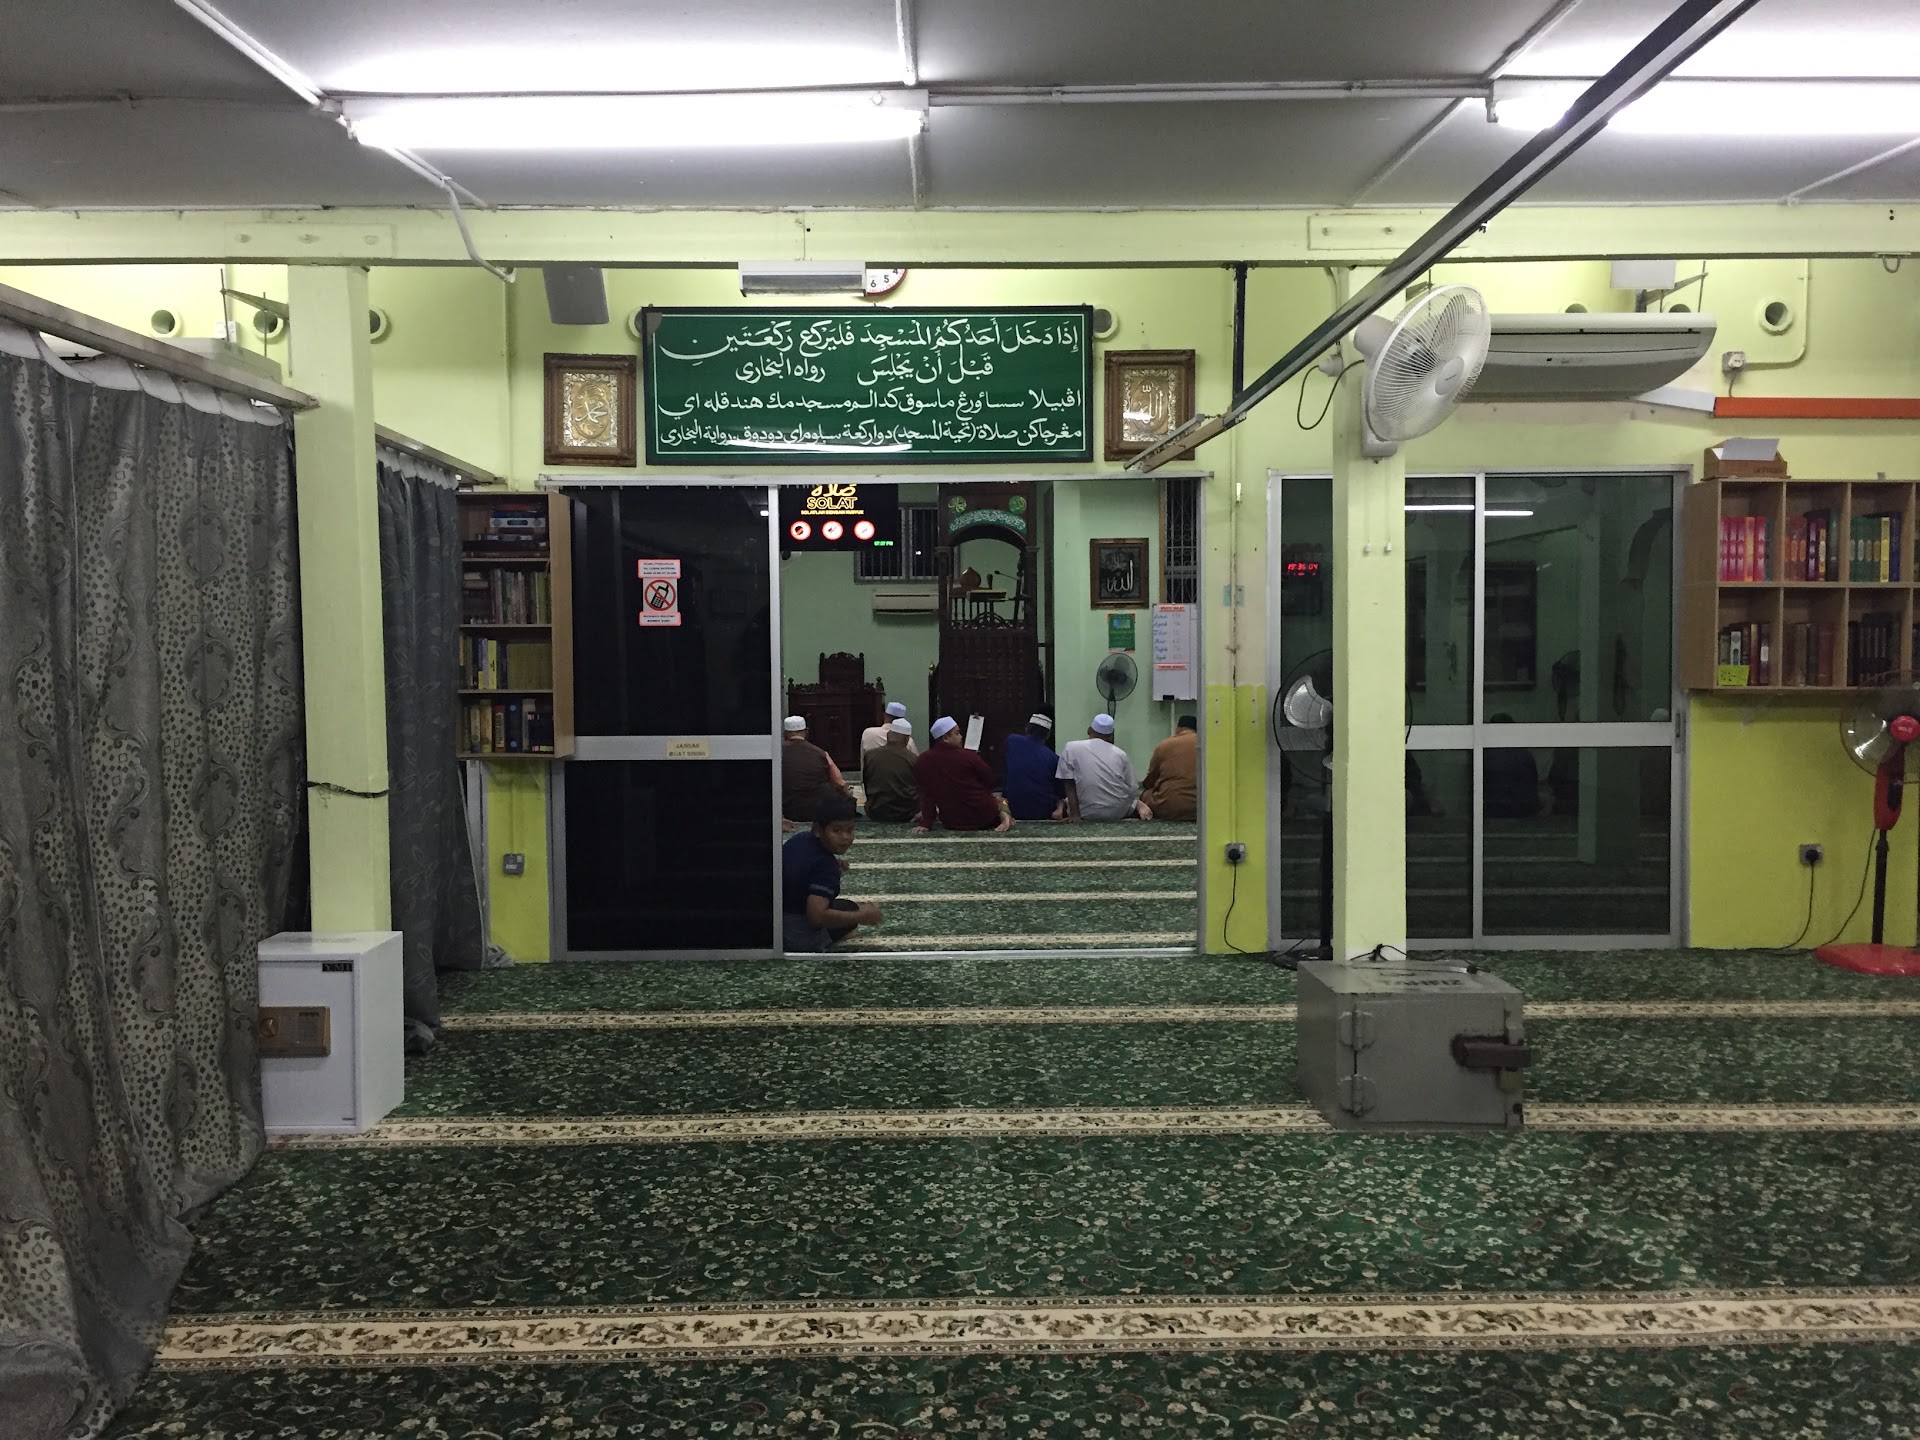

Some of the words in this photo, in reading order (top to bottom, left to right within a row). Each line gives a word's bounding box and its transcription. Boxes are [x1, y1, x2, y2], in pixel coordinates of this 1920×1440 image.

[870, 279, 877, 288] 6
[883, 275, 890, 284] 5
[794, 357, 826, 383] رواه
[899, 388, 955, 415] ماسوق
[806, 496, 858, 510] SOLAT
